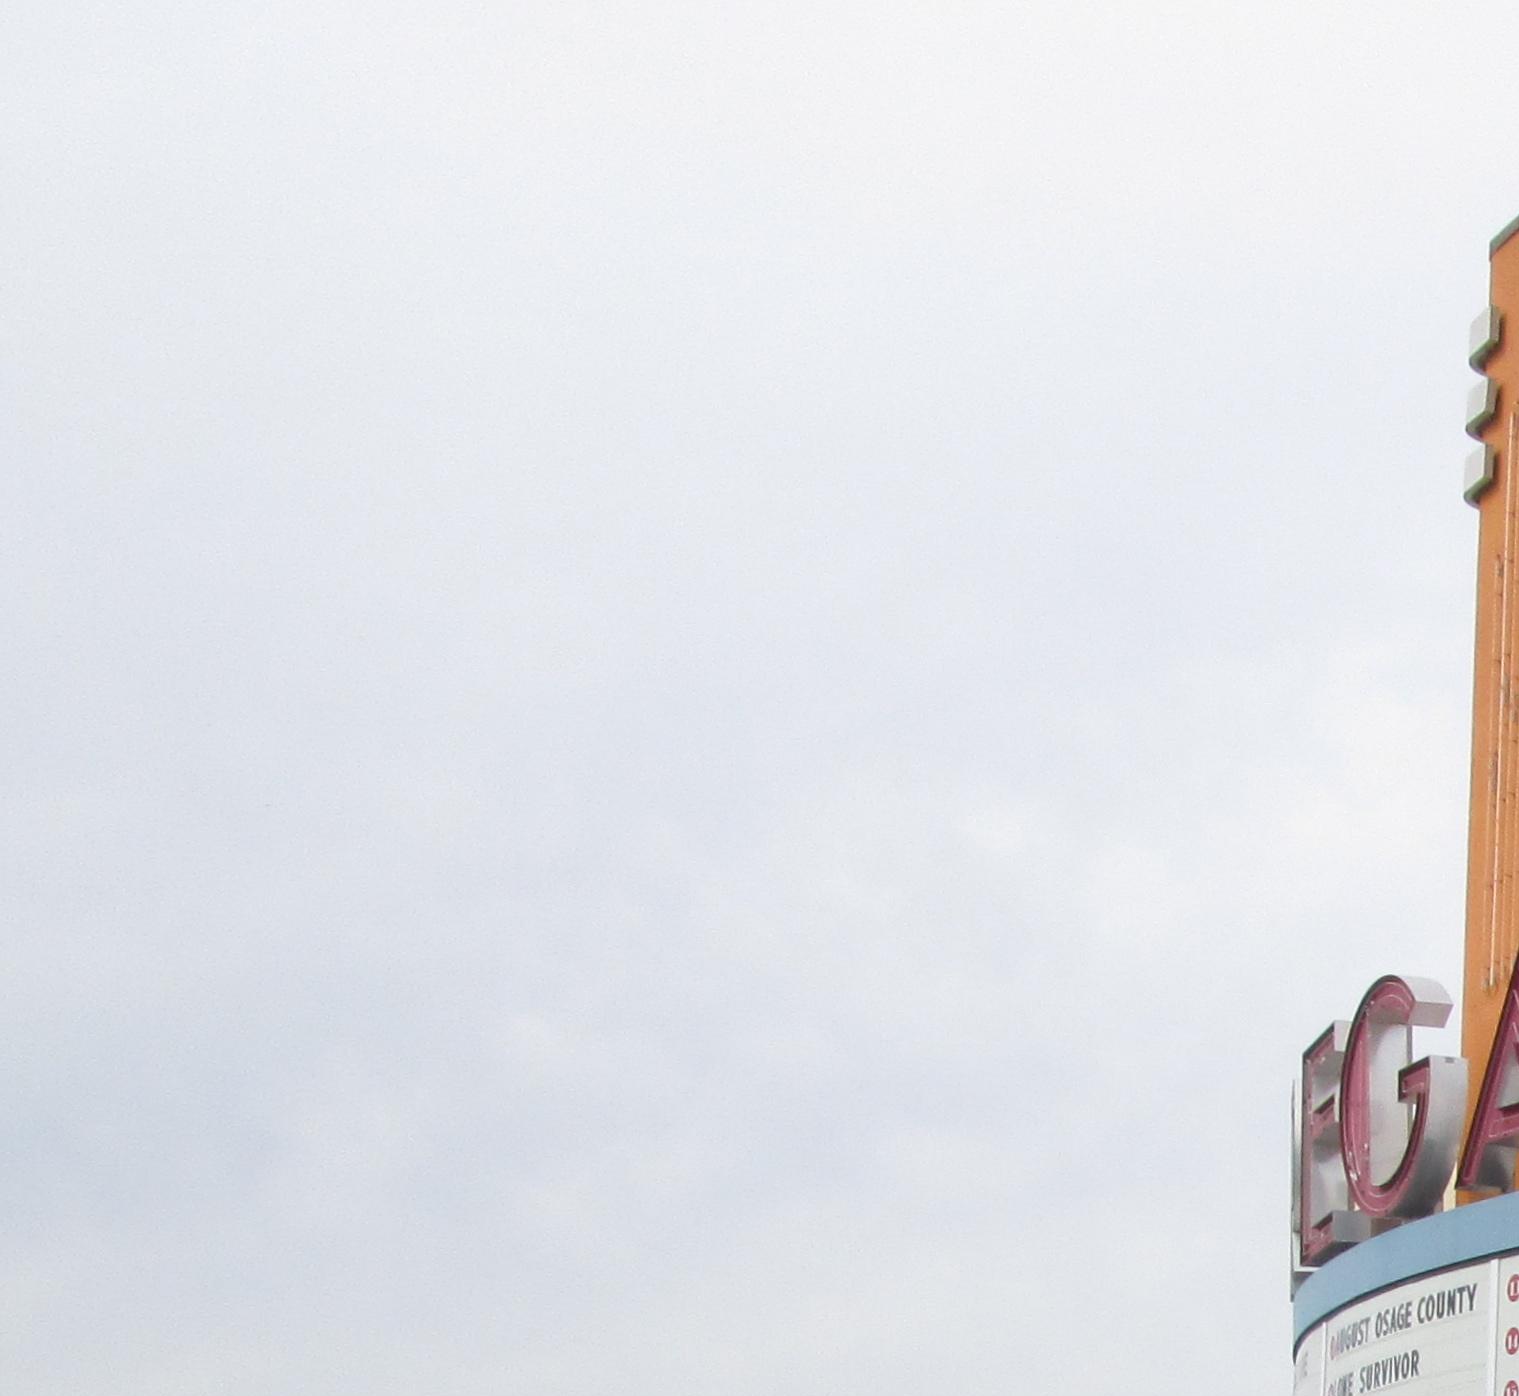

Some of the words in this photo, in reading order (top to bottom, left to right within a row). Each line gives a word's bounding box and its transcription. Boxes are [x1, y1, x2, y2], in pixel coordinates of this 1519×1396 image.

[1375, 1301, 1413, 1339] OSAGE
[1417, 1283, 1478, 1324] COUNTY
[1359, 1349, 1420, 1394] SURVIVOR
